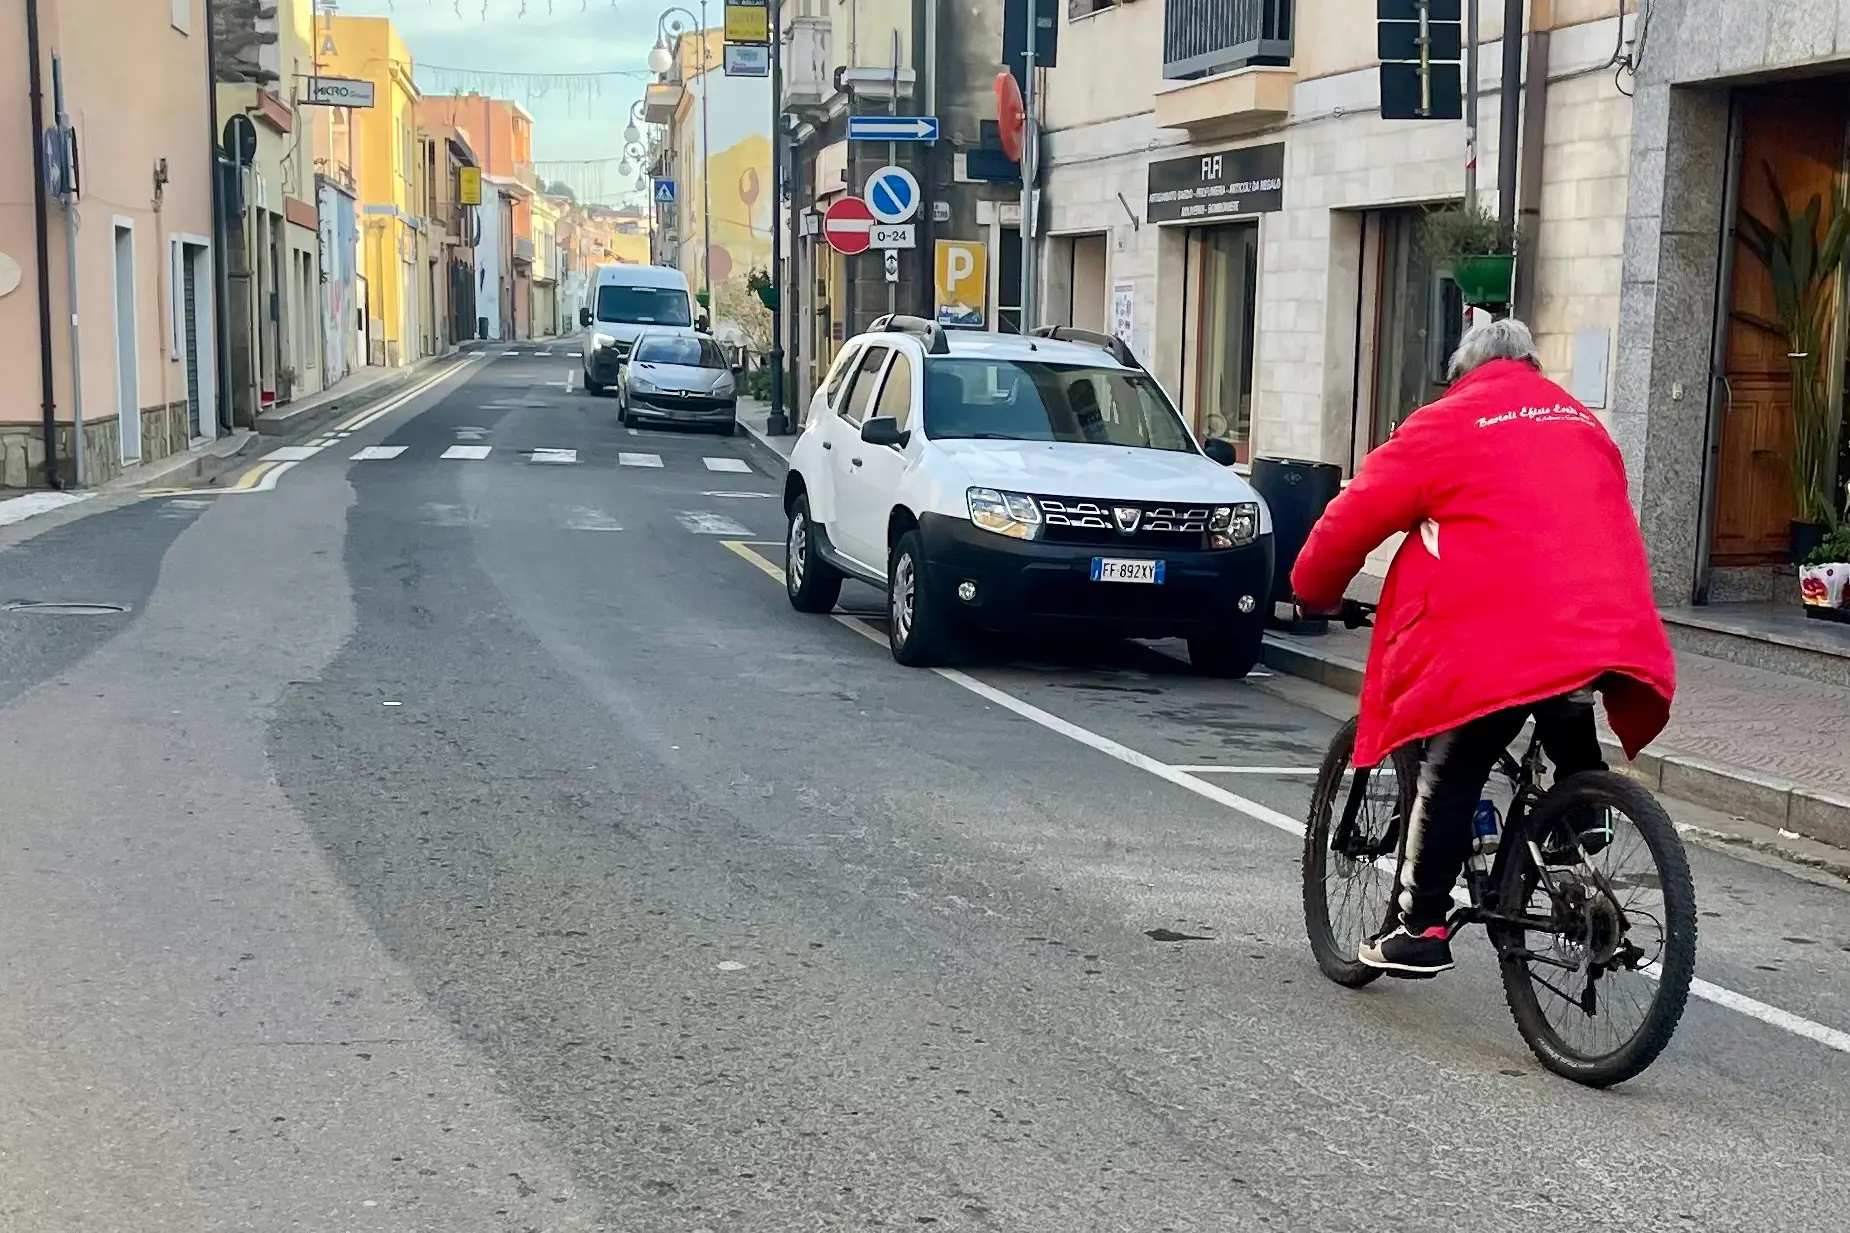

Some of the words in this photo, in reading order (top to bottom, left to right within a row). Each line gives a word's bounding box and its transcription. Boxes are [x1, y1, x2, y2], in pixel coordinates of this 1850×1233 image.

[877, 231, 907, 242] 0-24
[947, 247, 973, 291] P
[1103, 562, 1117, 577] FF
[1119, 563, 1155, 579] 892XY
